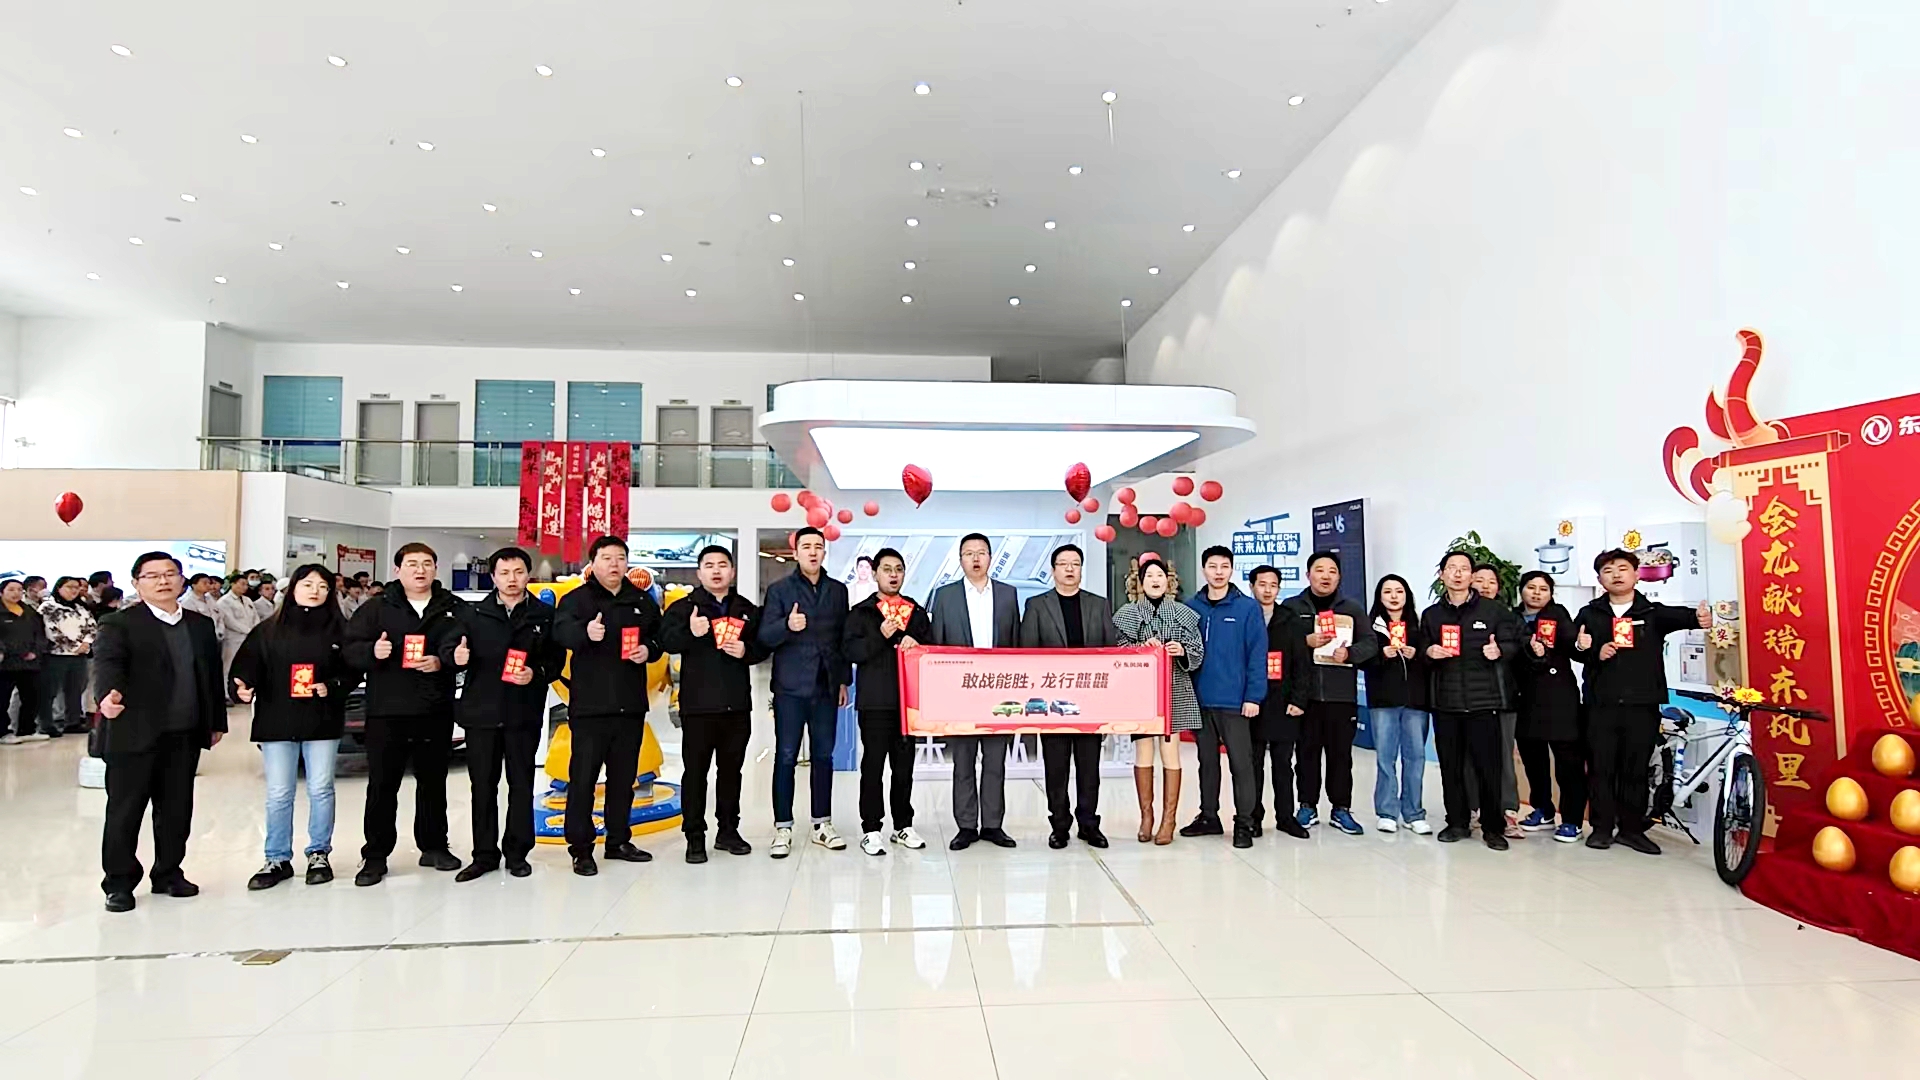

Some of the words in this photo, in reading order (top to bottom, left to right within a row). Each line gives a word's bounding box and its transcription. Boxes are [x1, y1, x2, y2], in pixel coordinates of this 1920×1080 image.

[1758, 495, 1811, 790] 金龙献瑞东风里
